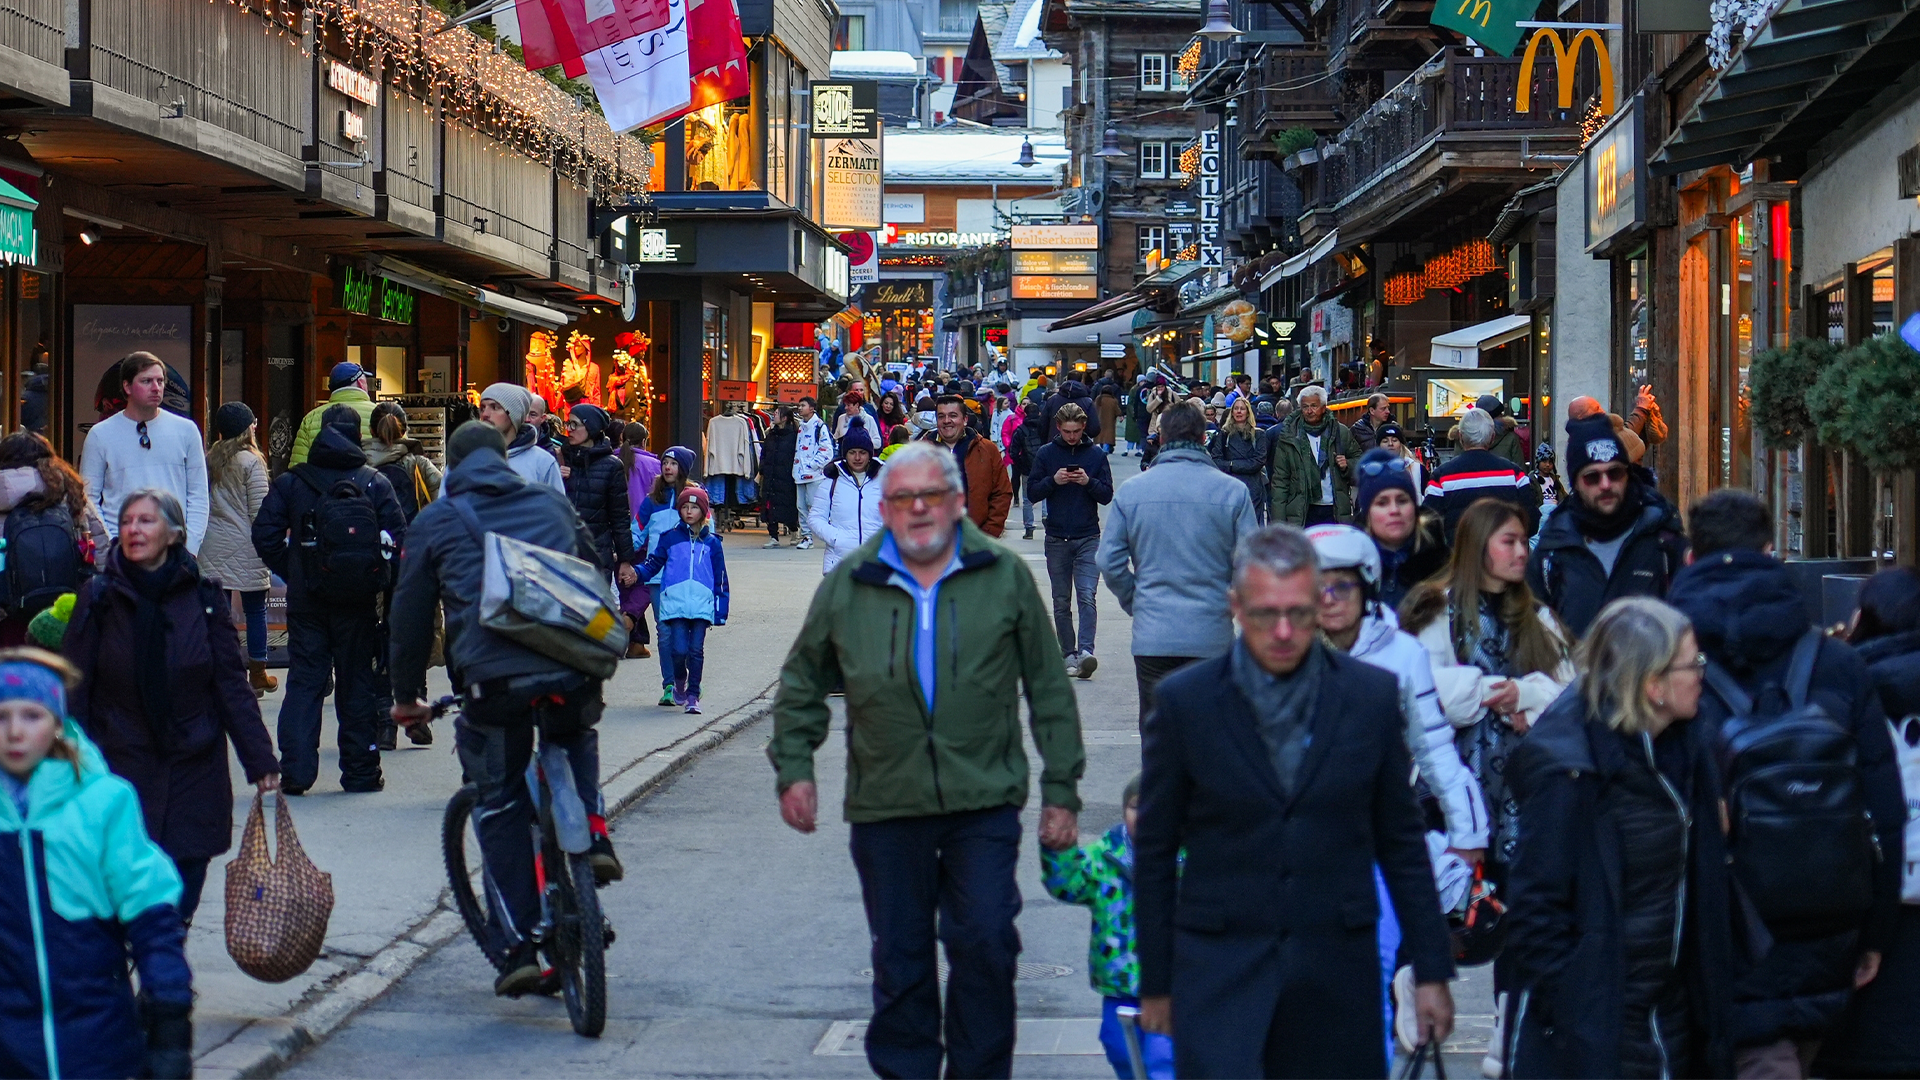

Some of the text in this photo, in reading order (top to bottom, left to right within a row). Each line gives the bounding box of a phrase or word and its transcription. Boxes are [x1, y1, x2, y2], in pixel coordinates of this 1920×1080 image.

[828, 156, 879, 170] ZERMATT
[828, 172, 879, 185] SELECTION
[905, 232, 998, 246] RISTORANTE
[1013, 235, 1096, 245] walliserkanne
[873, 283, 914, 303] Lindt
[83, 319, 120, 345] Elegance
[121, 322, 129, 337] is
[142, 322, 182, 339] attitude
[267, 357, 295, 366] LONGINES
